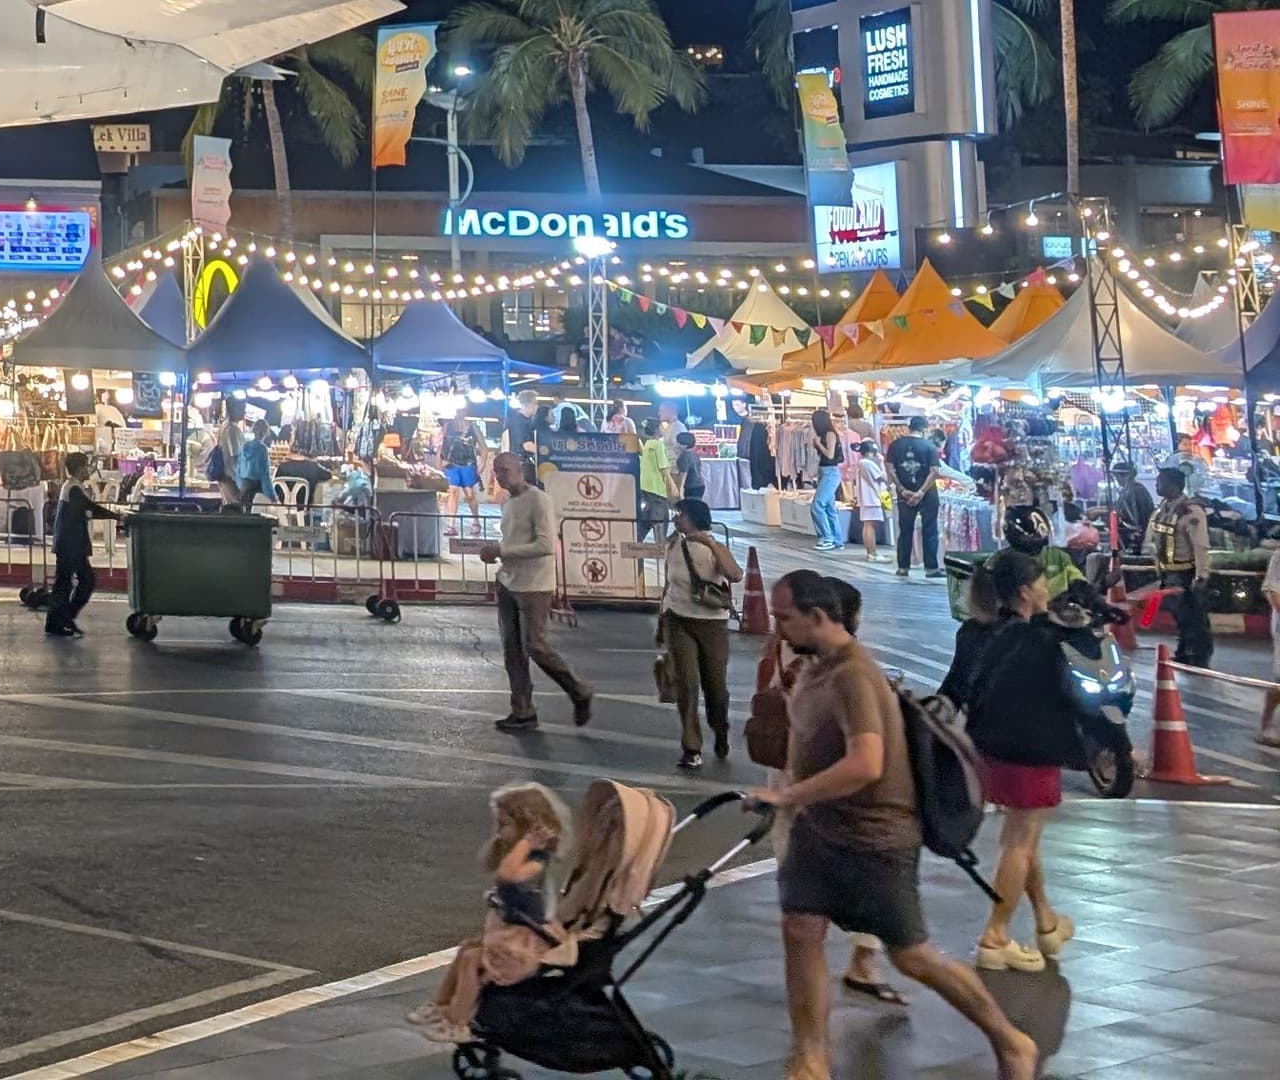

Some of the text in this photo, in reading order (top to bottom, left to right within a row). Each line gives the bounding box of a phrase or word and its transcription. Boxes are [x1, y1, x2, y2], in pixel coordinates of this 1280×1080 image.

[865, 24, 907, 54] LUSH
[867, 50, 908, 75] FRESH
[868, 71, 909, 88] HANDMADE
[868, 83, 910, 102] COSMETICS
[117, 126, 147, 143] Villa
[443, 208, 689, 239] McDonald's
[861, 247, 889, 267] HOURS
[571, 542, 583, 550] NO
